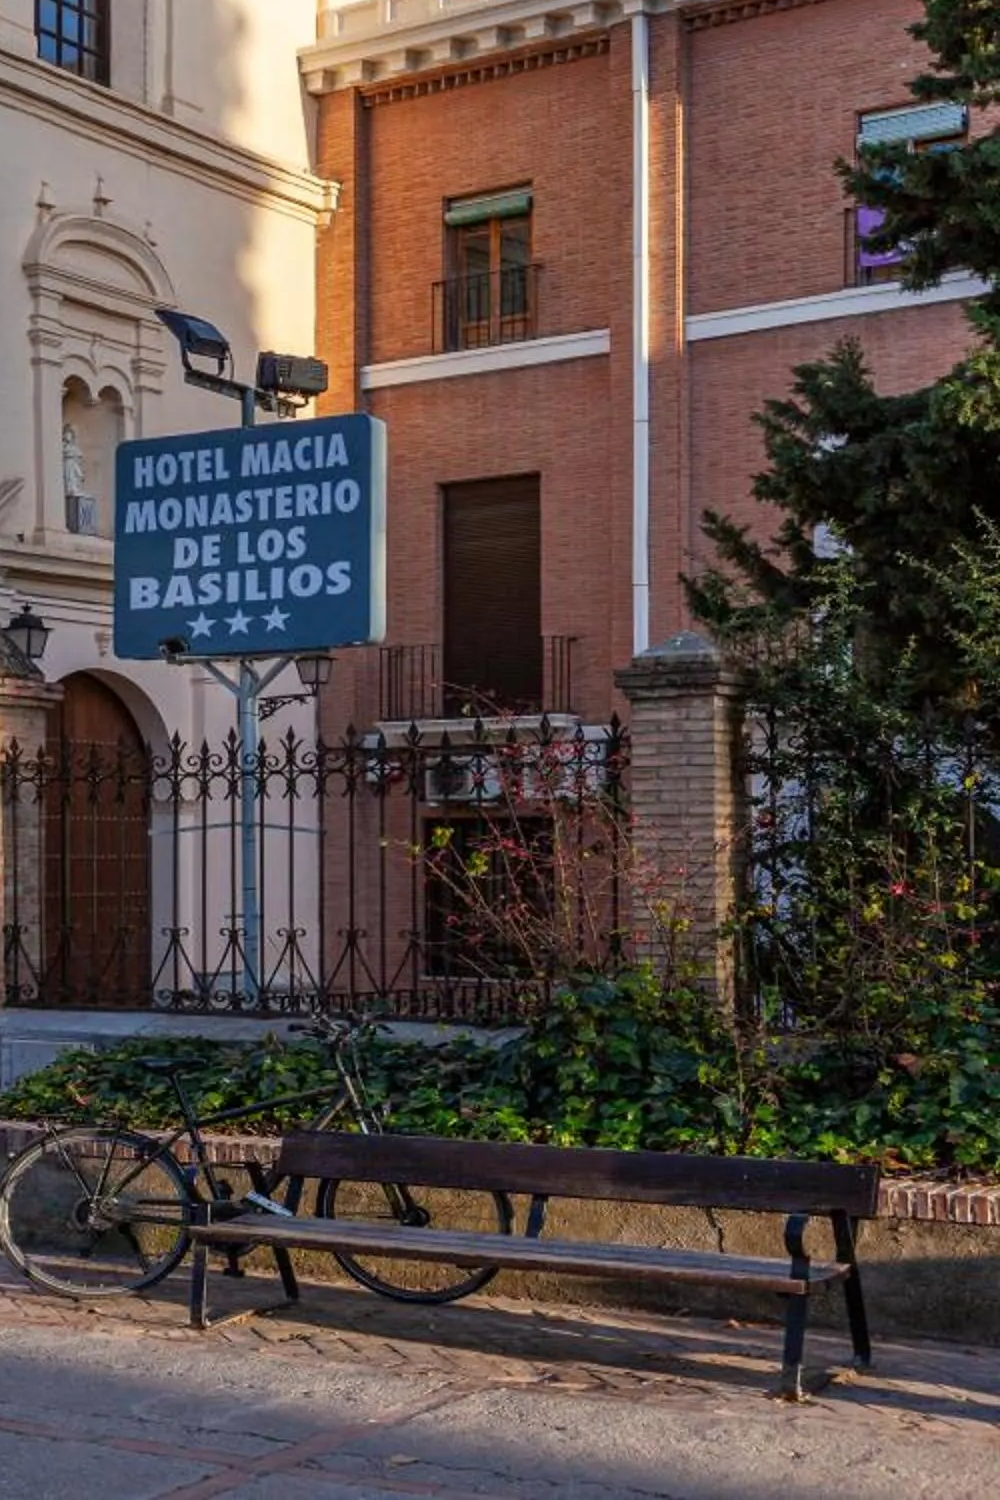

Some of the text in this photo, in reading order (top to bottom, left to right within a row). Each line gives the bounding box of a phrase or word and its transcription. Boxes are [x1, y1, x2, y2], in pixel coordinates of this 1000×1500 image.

[134, 432, 350, 489] HOTEL MACIA
[124, 479, 361, 533] MONASTERIO
[173, 525, 308, 570] DE LOS
[129, 560, 352, 611] BASILIOS
